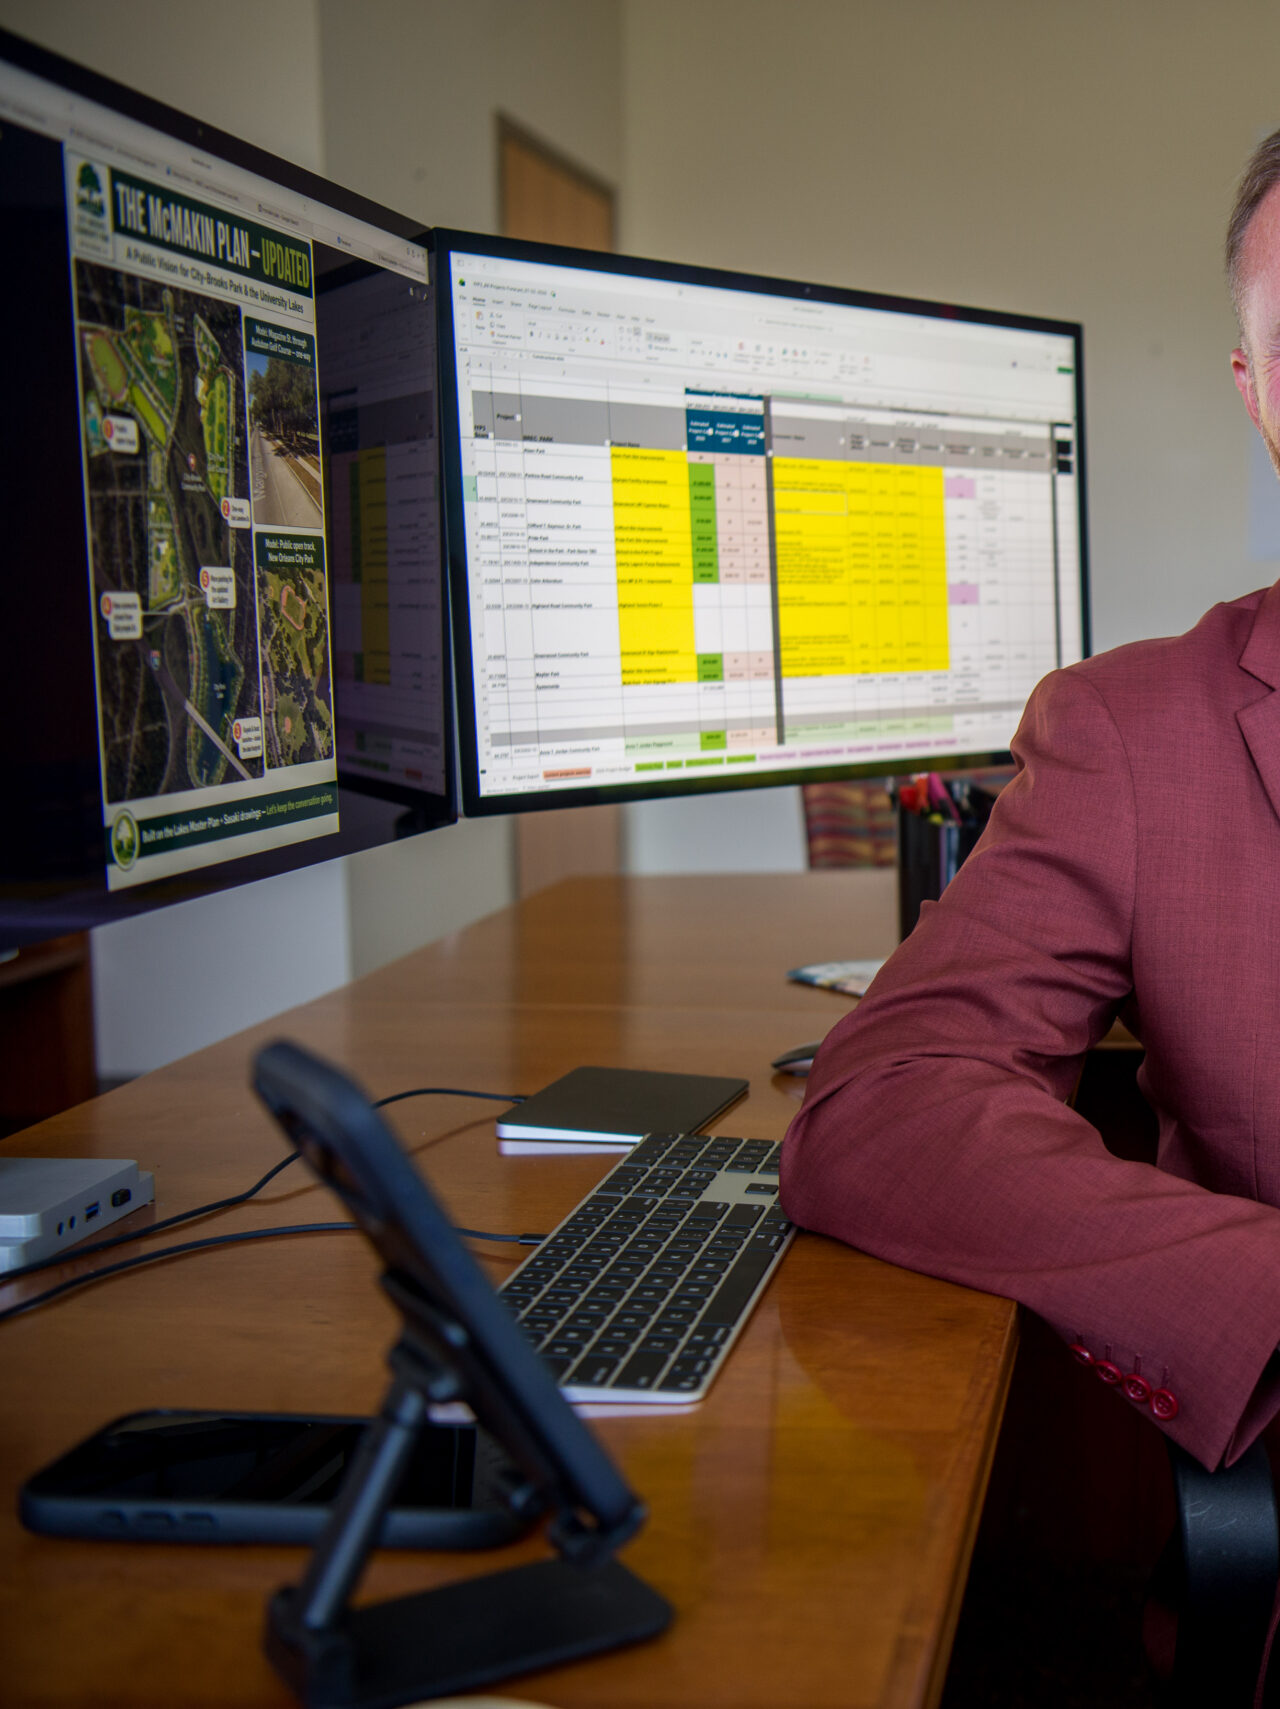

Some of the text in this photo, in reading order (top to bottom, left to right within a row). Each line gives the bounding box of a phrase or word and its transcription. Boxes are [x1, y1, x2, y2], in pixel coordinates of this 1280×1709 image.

[114, 181, 147, 233] THE
[148, 194, 216, 257] McMAKIN
[216, 221, 250, 269] PLAN
[261, 237, 310, 289] UPDATED
[126, 246, 132, 258] A
[134, 248, 156, 269] Public
[158, 257, 178, 274] Vision
[179, 264, 188, 278] for
[190, 266, 228, 291] City-Brooks
[229, 280, 243, 295] Park
[249, 286, 259, 299] the
[260, 289, 288, 311] University
[288, 298, 304, 313] Lakes
[268, 329, 286, 343] Magazine
[292, 336, 307, 349] through
[268, 341, 278, 352] Golf
[278, 344, 291, 356] Course
[279, 539, 293, 550] Public
[293, 543, 304, 552] open
[304, 541, 316, 552] track,
[267, 552, 314, 565] New Orleans City Park
[142, 830, 156, 843] Built
[156, 830, 164, 840] on
[164, 827, 173, 838] the
[173, 823, 189, 836] Lakes
[190, 820, 208, 833] Master
[208, 816, 220, 828] Plan
[223, 812, 240, 825] Sasaki
[240, 809, 262, 822] drawings
[276, 804, 288, 814] keep
[295, 796, 320, 809] conversation
